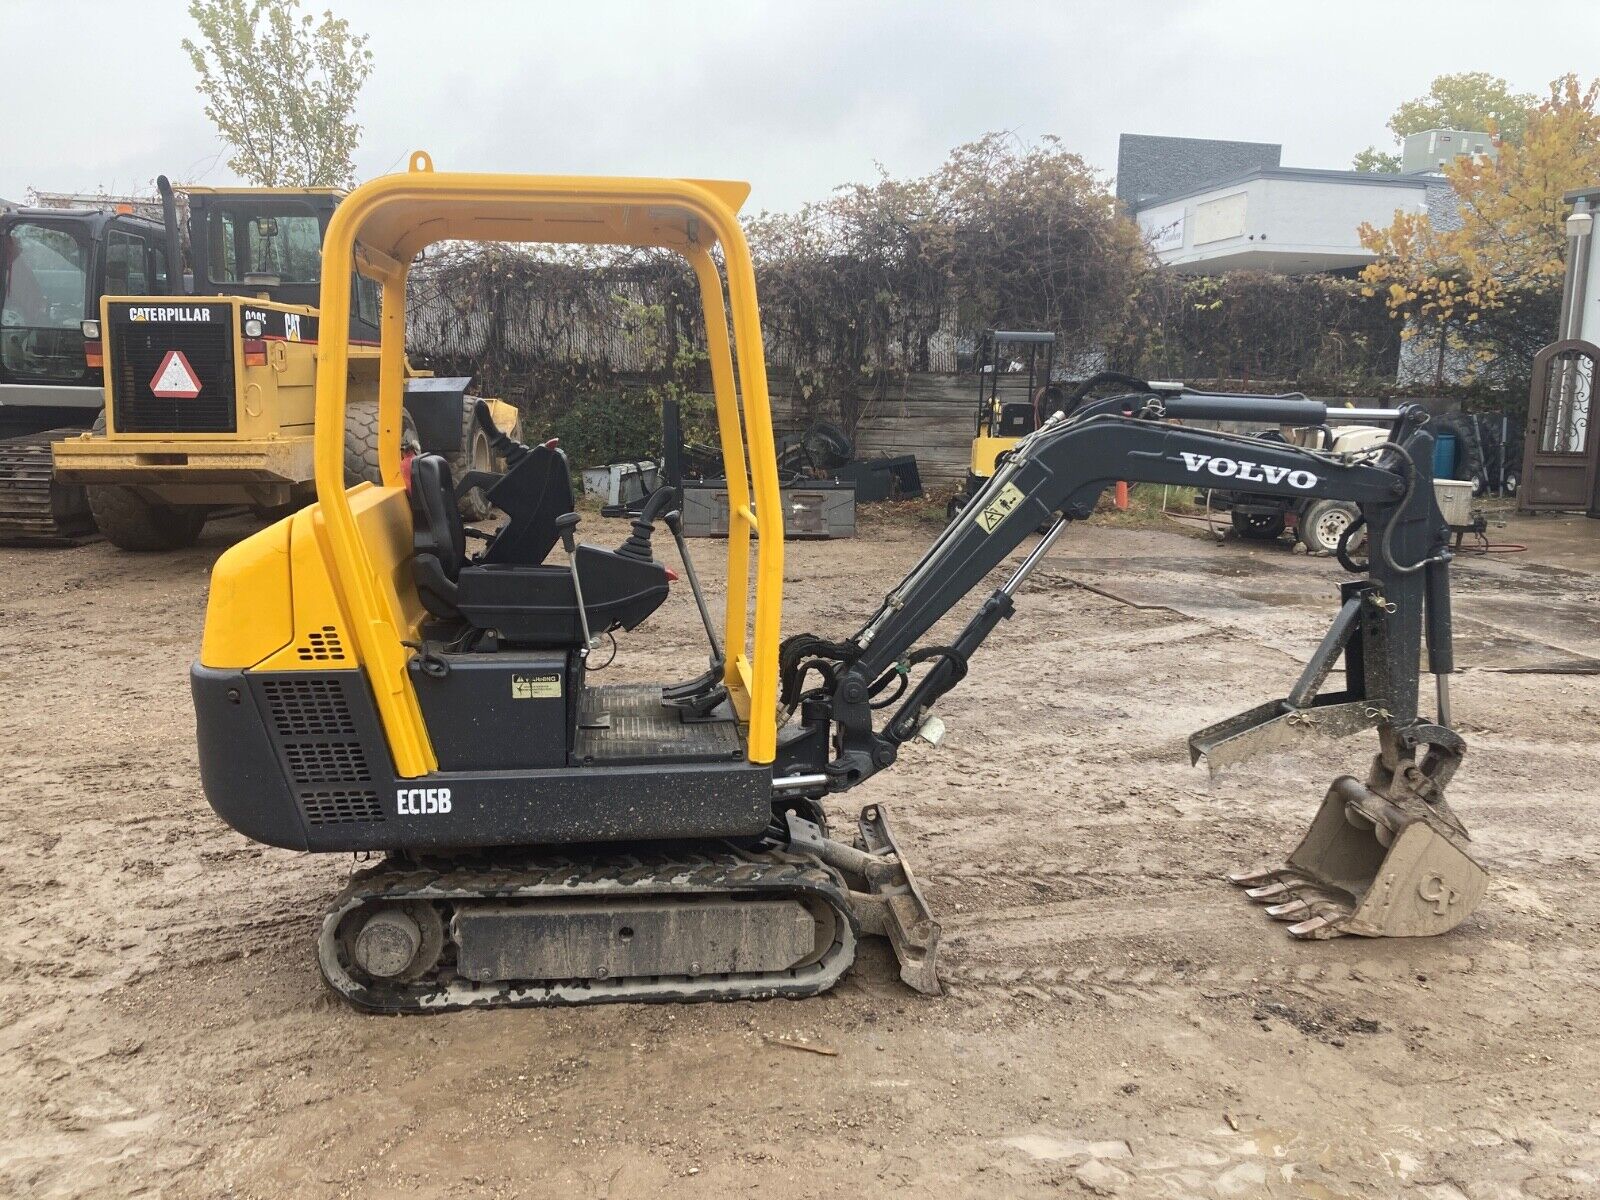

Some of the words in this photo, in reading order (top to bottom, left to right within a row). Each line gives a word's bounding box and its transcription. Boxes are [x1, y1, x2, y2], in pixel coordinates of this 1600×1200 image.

[129, 307, 210, 322] CATERPILLAR
[284, 312, 300, 342] CAT
[1179, 451, 1318, 489] VOLVO
[397, 788, 452, 815] EC15B
